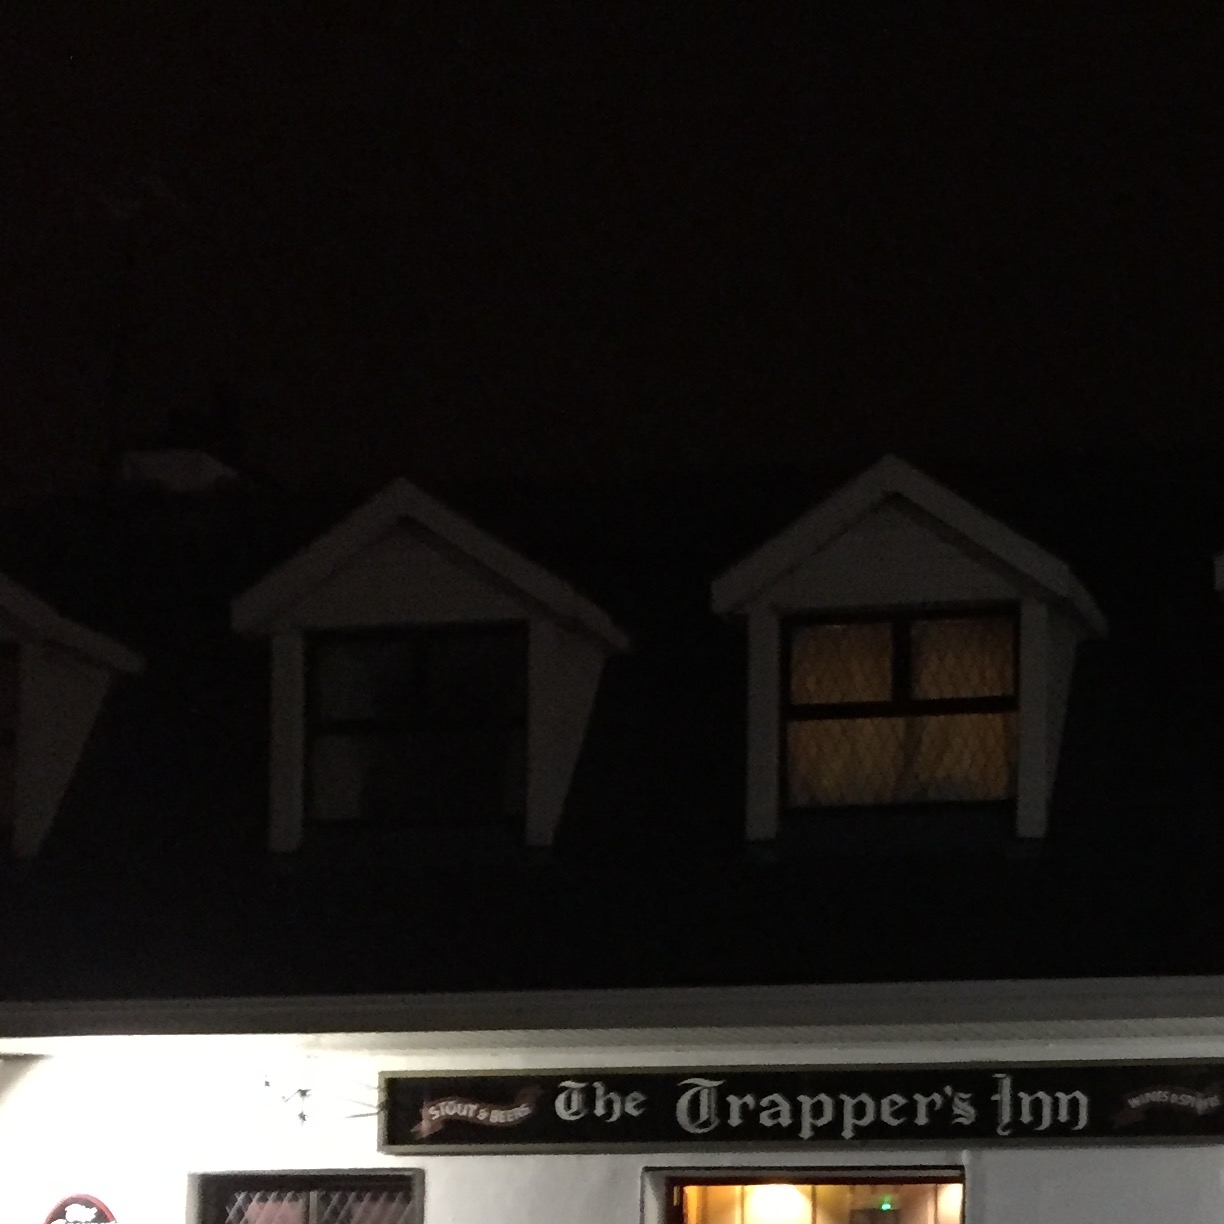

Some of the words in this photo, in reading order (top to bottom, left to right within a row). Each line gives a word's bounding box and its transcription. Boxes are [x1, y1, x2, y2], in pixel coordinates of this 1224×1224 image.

[428, 1100, 479, 1120] STOUT
[489, 1103, 532, 1123] BEERS
[553, 1080, 648, 1122] The
[676, 1077, 977, 1139] Trapper's
[991, 1073, 1089, 1136] Inn
